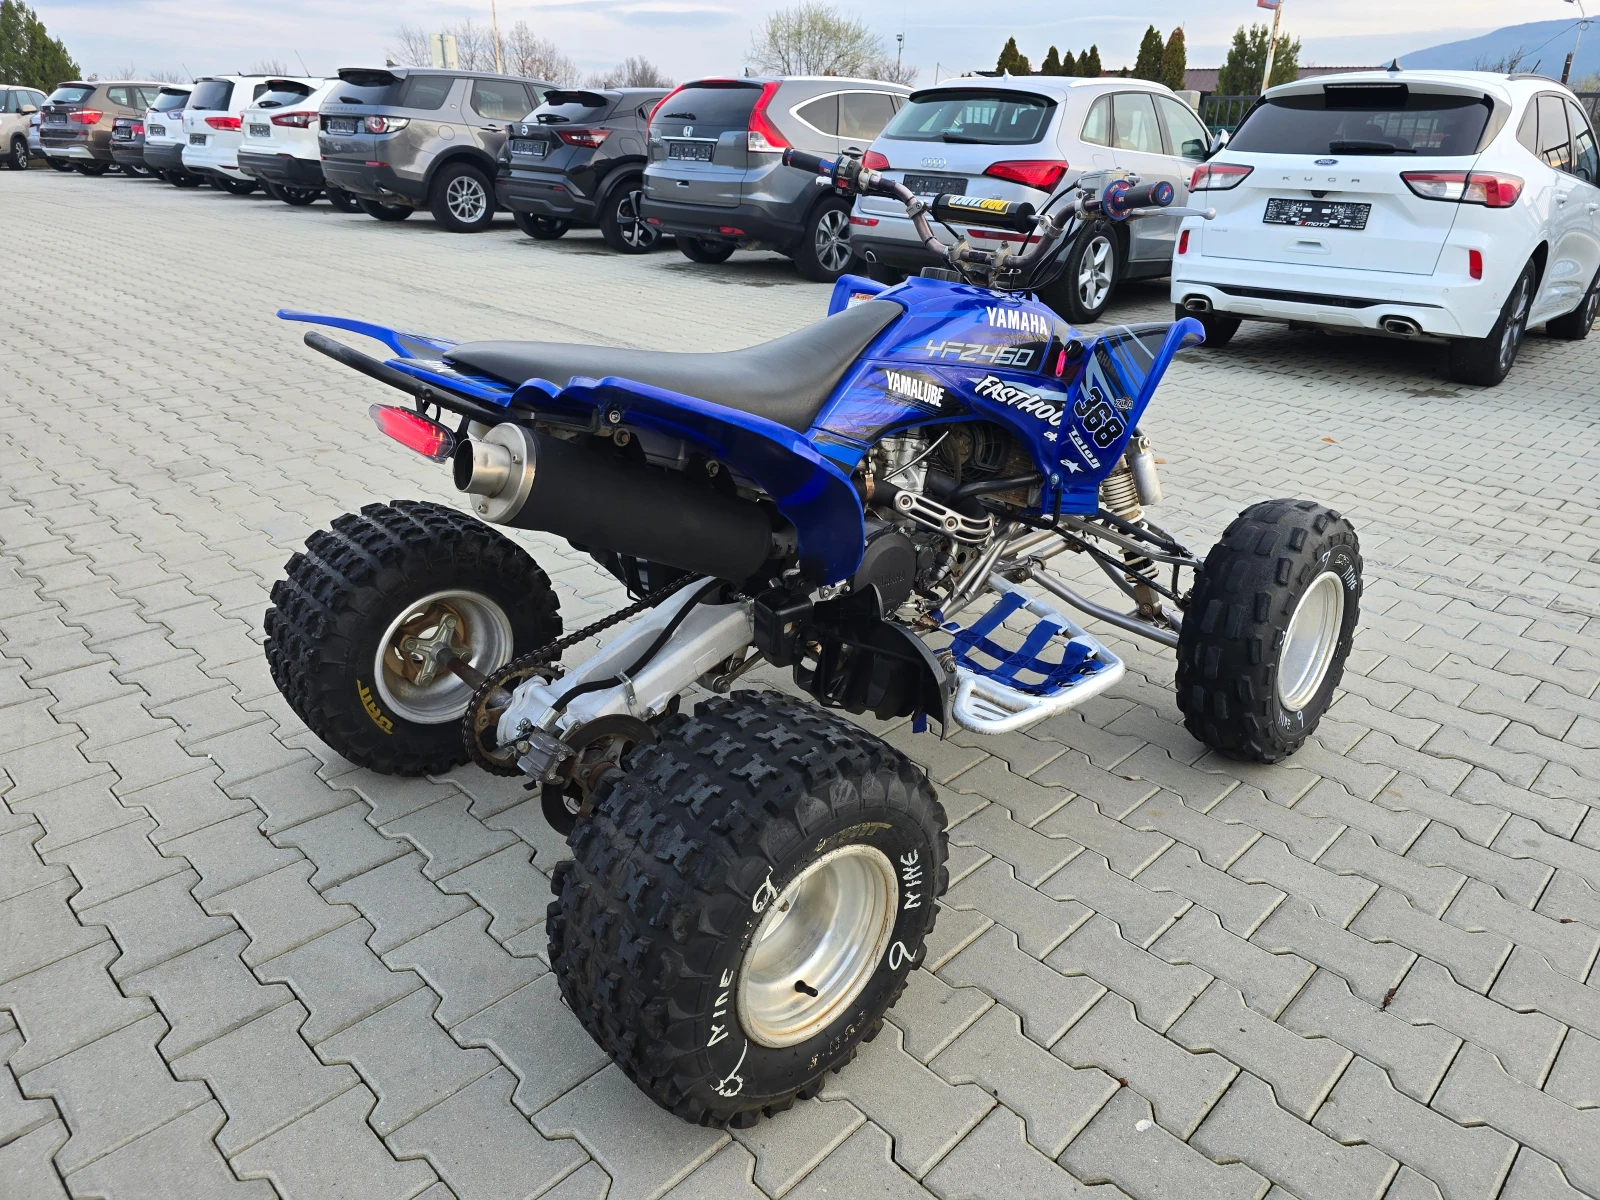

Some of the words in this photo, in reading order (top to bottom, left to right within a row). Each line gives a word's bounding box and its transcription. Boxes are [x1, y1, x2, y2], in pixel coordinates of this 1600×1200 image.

[1282, 175, 1360, 184] KUGA
[986, 306, 1048, 336] YAMAHA
[925, 339, 1035, 367] YFZ450
[886, 370, 945, 408] YAMALUBE
[1074, 386, 1125, 449] 368
